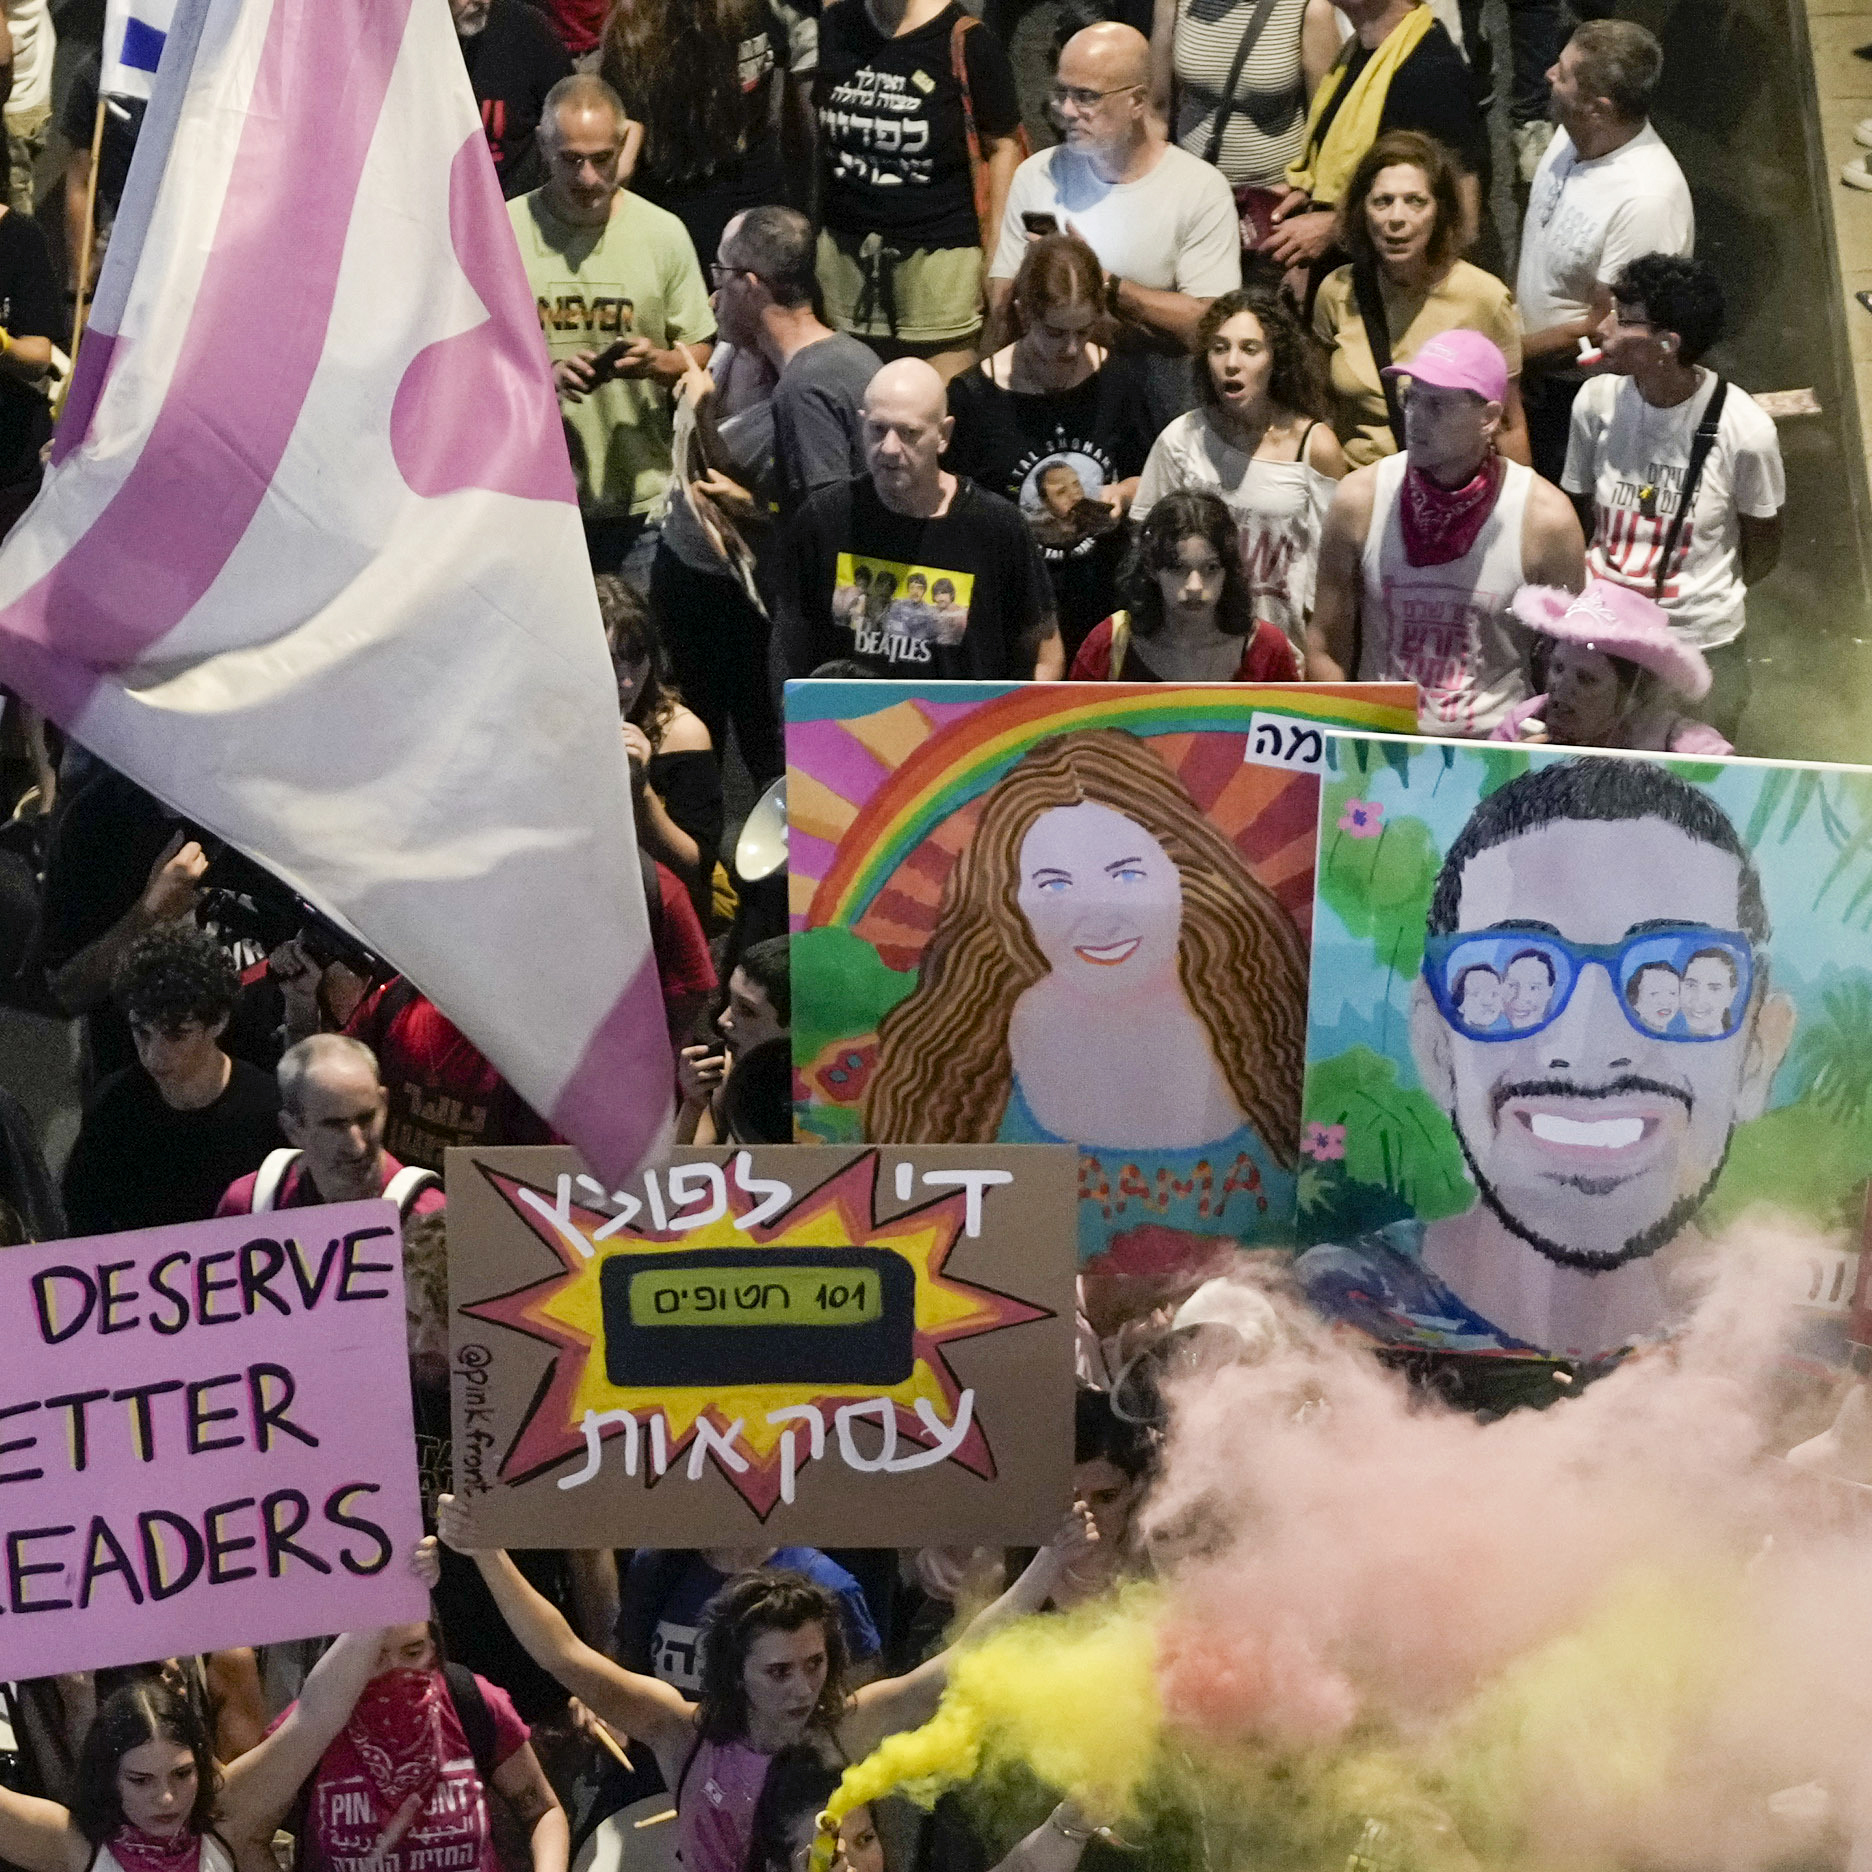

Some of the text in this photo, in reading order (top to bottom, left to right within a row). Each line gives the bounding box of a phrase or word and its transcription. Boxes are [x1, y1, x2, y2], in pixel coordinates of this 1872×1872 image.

[517, 1150, 1015, 1259] די לפוצץ
[31, 1226, 395, 1346] DESERVE
[654, 1281, 867, 1315] 101 חטופים
[556, 1387, 976, 1505] עסקאות
